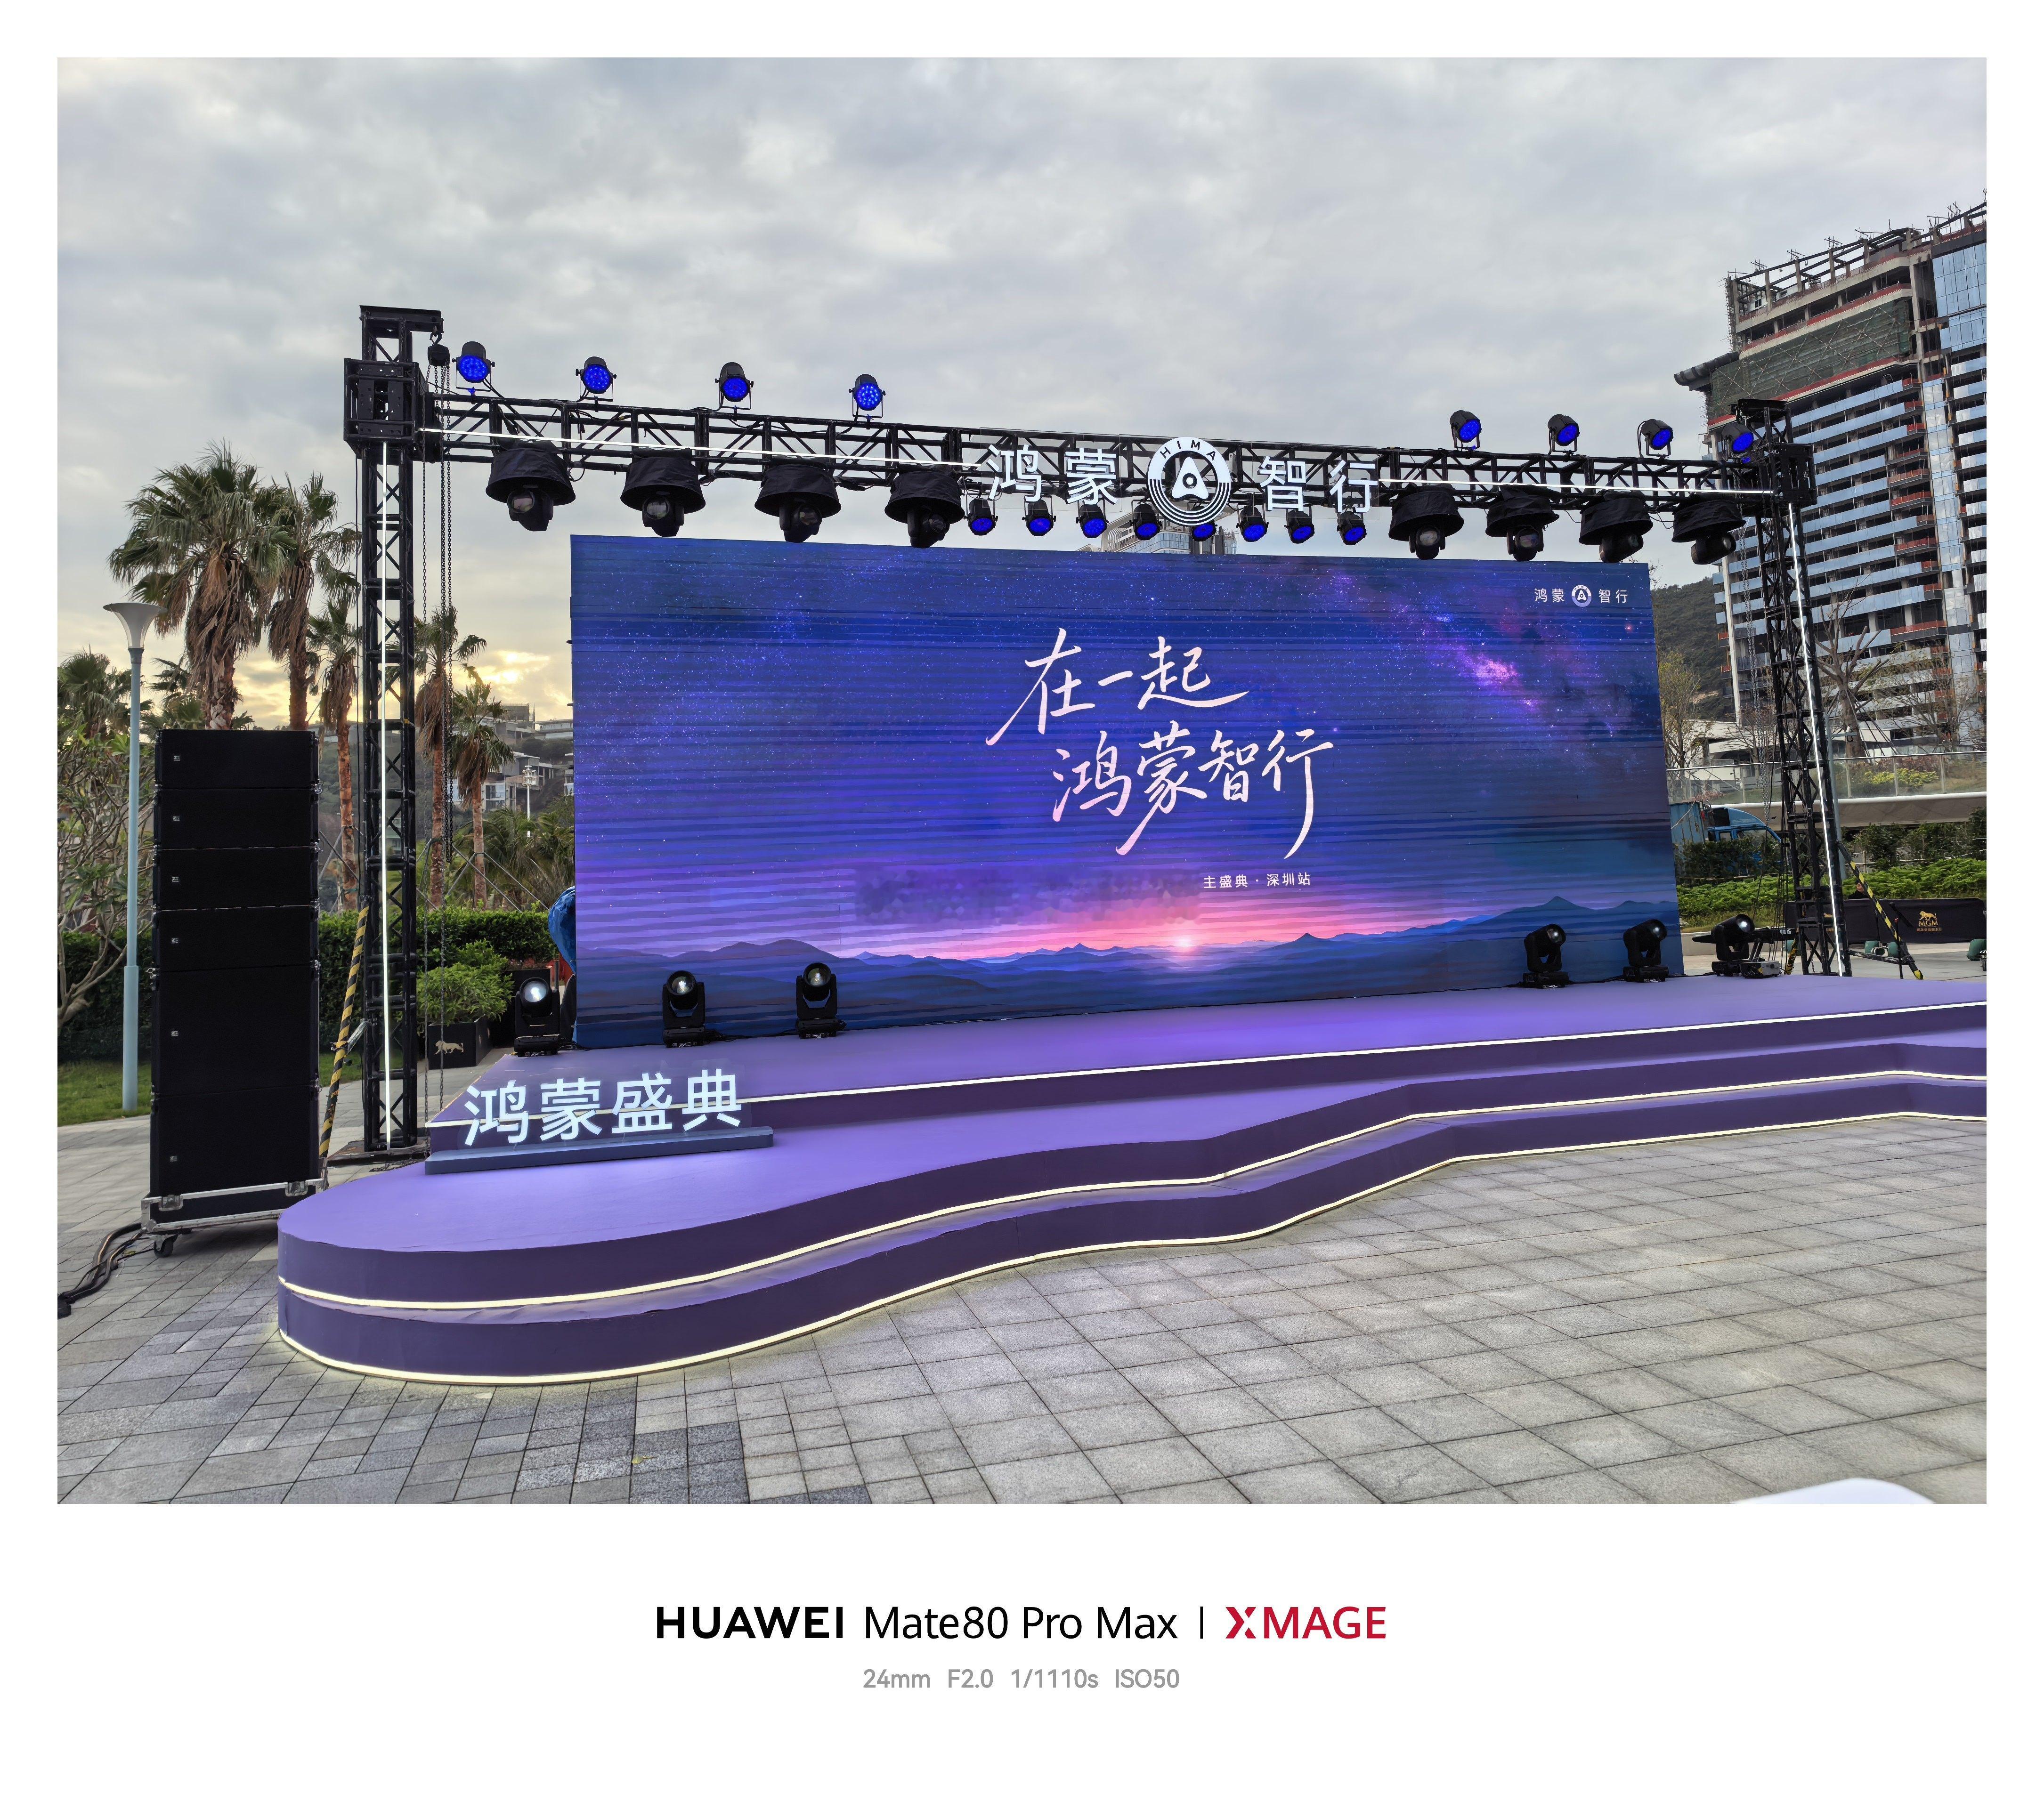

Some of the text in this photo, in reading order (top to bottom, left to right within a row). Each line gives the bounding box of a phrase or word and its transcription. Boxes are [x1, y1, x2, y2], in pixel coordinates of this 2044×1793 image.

[986, 444, 1379, 513] 鸿蒙 智行
[1160, 440, 1216, 461] HIMA
[1534, 588, 1628, 603] 鸿蒙 智行
[985, 628, 1249, 746] 在一起
[1052, 720, 1334, 859] 鸿蒙智行
[463, 1068, 742, 1146] 鸿蒙盛典
